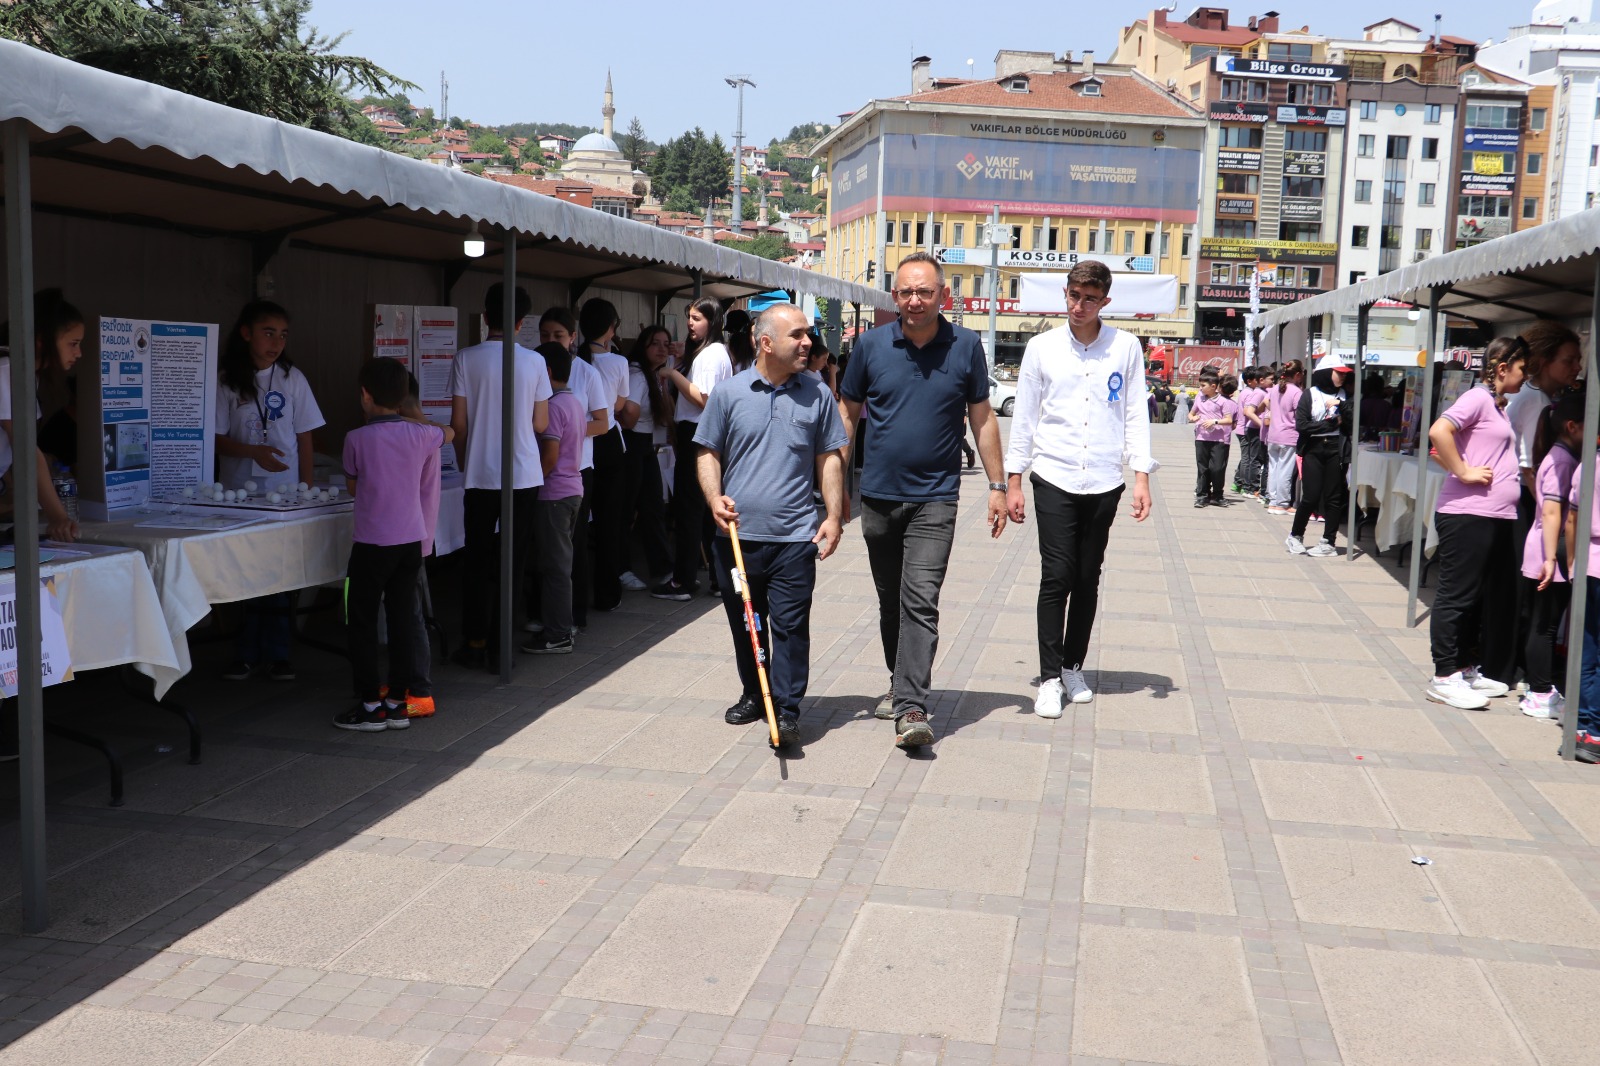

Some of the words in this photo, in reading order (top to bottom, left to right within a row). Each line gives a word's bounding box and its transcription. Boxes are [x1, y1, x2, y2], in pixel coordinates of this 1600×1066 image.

[1250, 61, 1285, 74] Bilge
[1291, 64, 1334, 77] Group
[971, 124, 1021, 134] VAKIFLAR
[1025, 125, 1059, 136] BÖLGE
[1062, 128, 1127, 140] MÜDÜRLÜĞÜ
[985, 156, 1019, 168] VAKIF
[984, 168, 1033, 181] KATILIM
[1070, 172, 1136, 183] YAŞATIYORUZ
[1011, 252, 1078, 262] KOSGEB
[102, 335, 130, 345] TABLODA
[102, 350, 134, 361] ERDEYİM?
